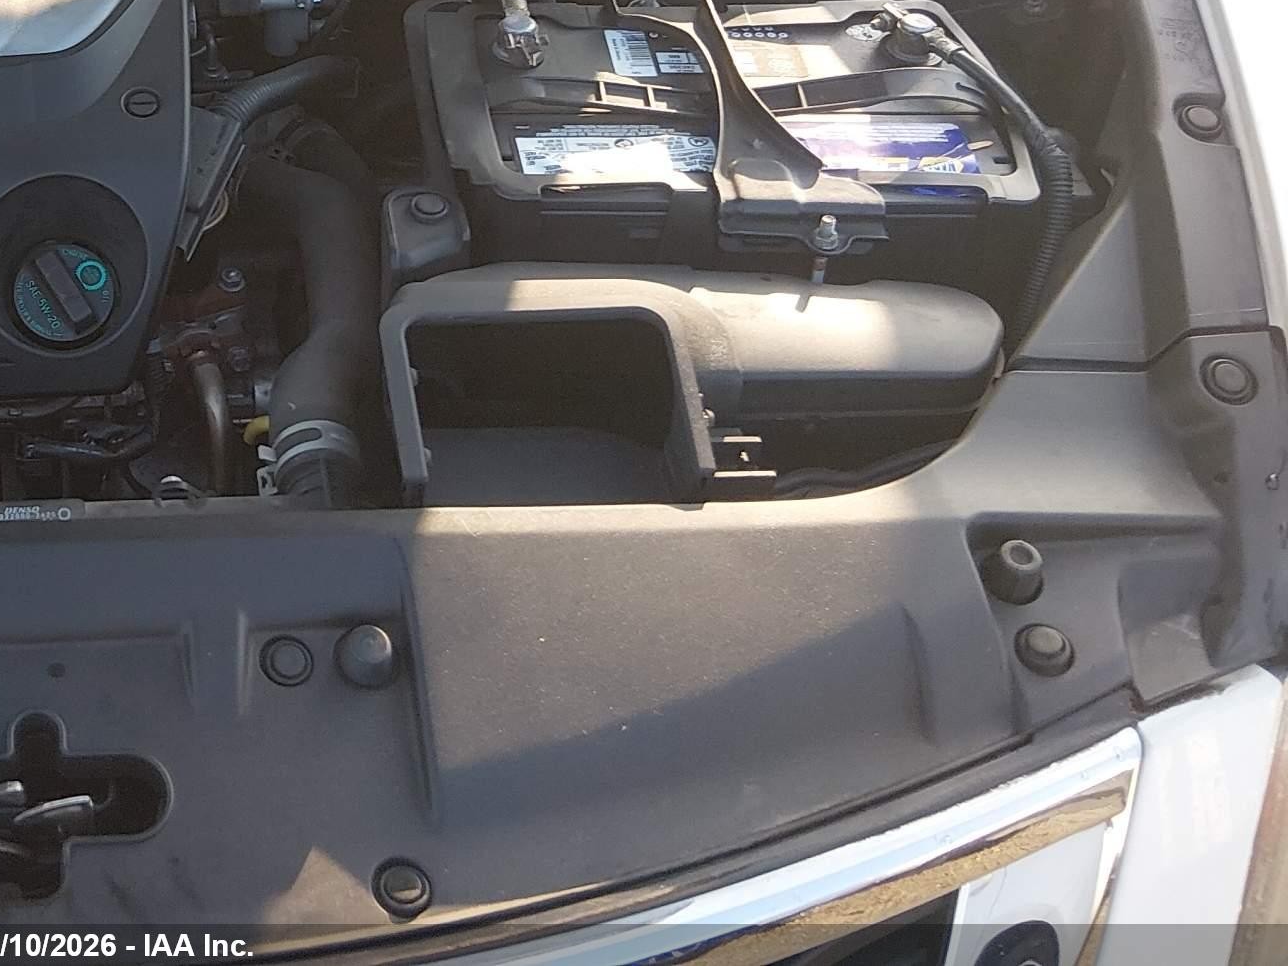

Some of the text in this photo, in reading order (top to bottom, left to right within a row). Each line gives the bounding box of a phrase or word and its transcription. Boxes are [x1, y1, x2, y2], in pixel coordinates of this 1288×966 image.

[25, 280, 42, 300] SAE
[39, 298, 62, 330] 5W-20
[4, 506, 40, 515] DENSO
